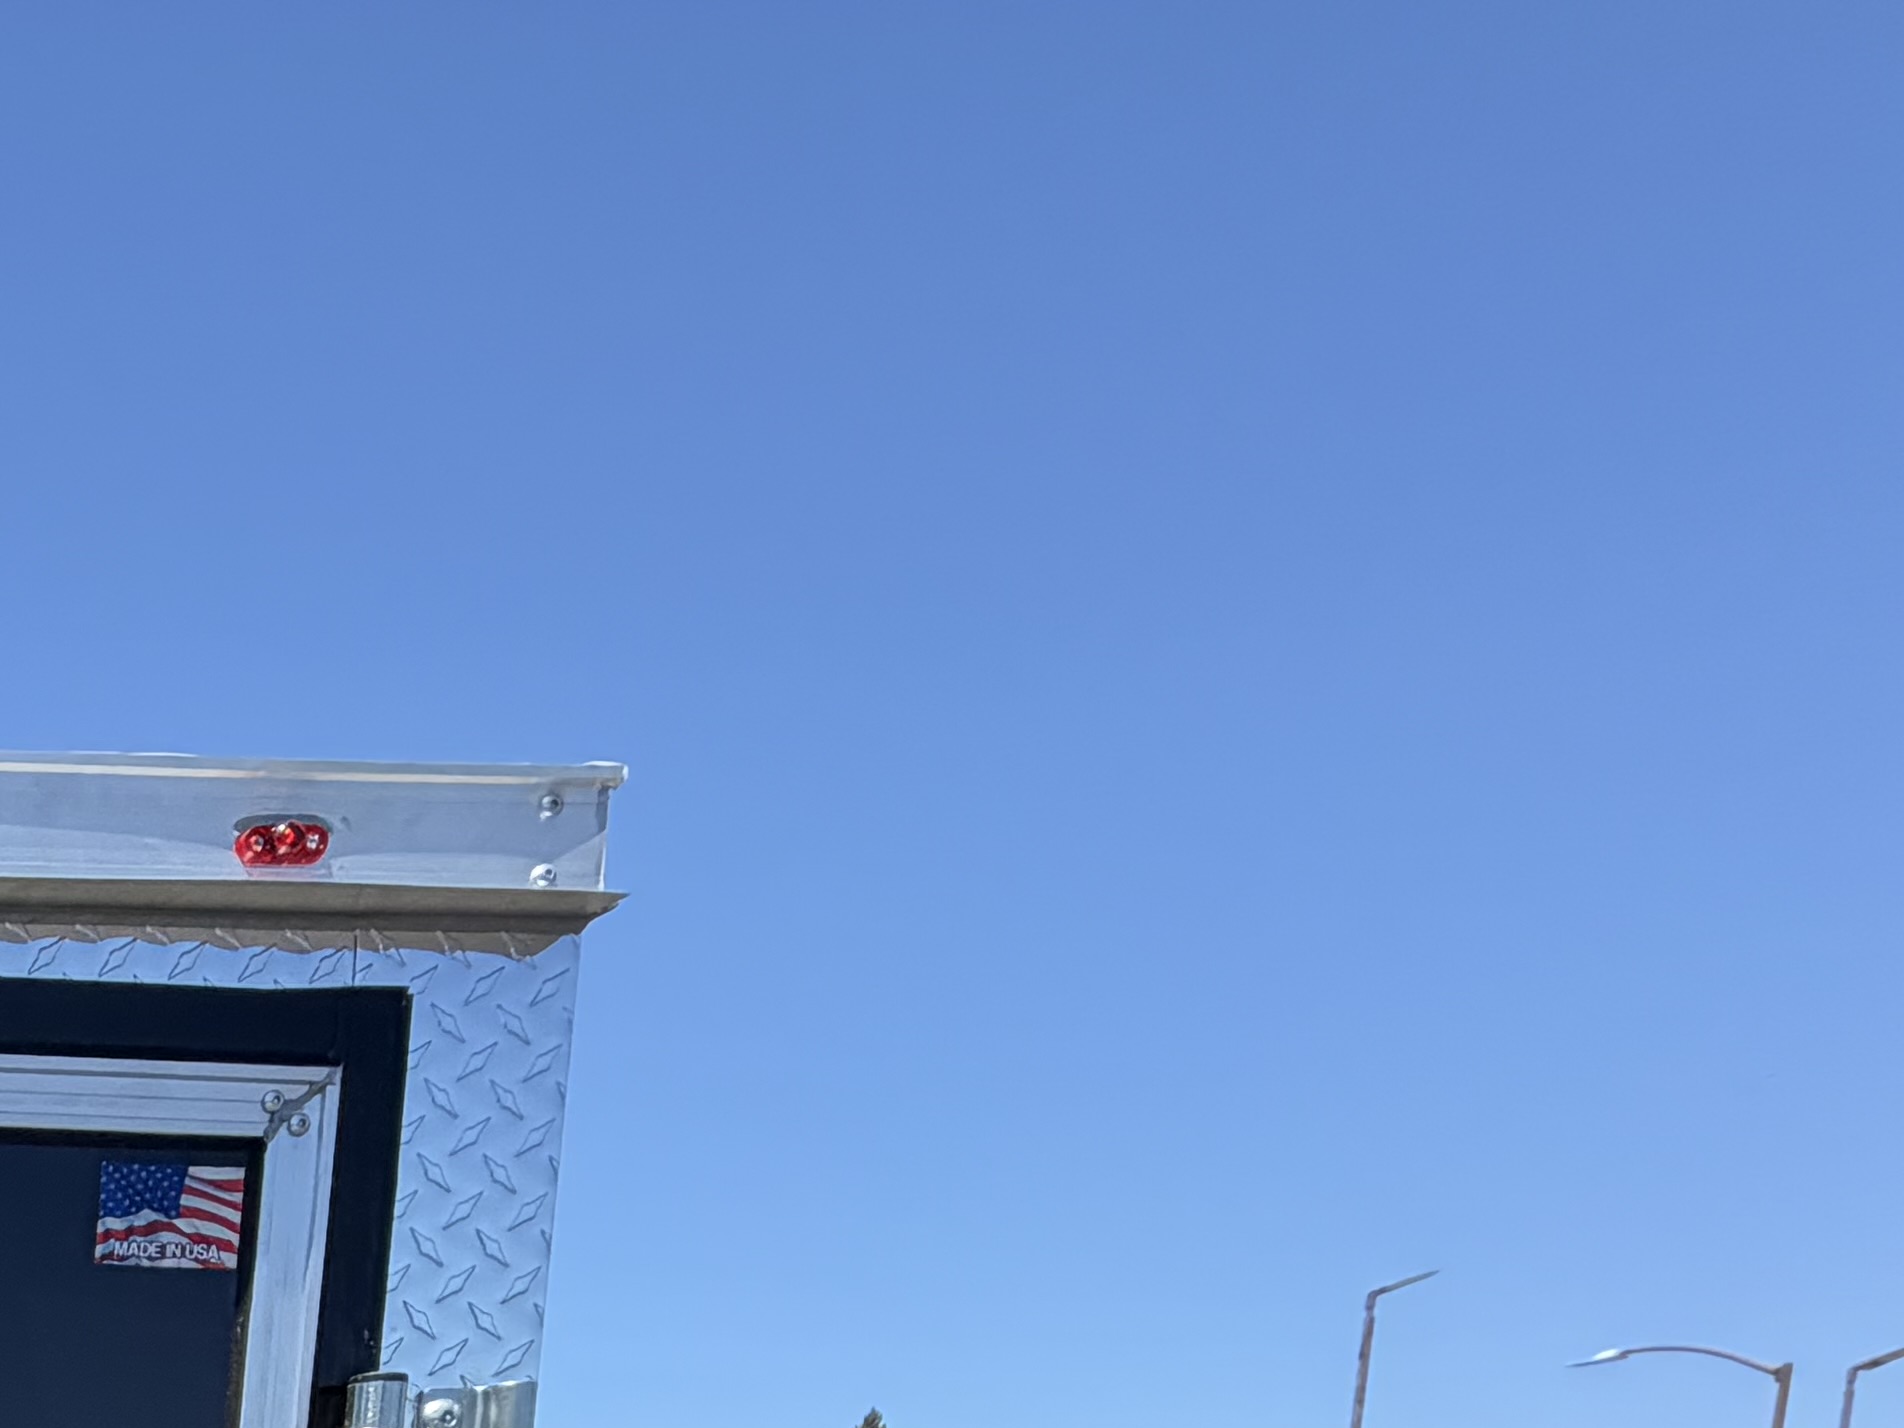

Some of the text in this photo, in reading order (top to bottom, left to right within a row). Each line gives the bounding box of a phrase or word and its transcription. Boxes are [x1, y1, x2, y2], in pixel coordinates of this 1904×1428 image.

[113, 1241, 222, 1261] MADE IN USA
